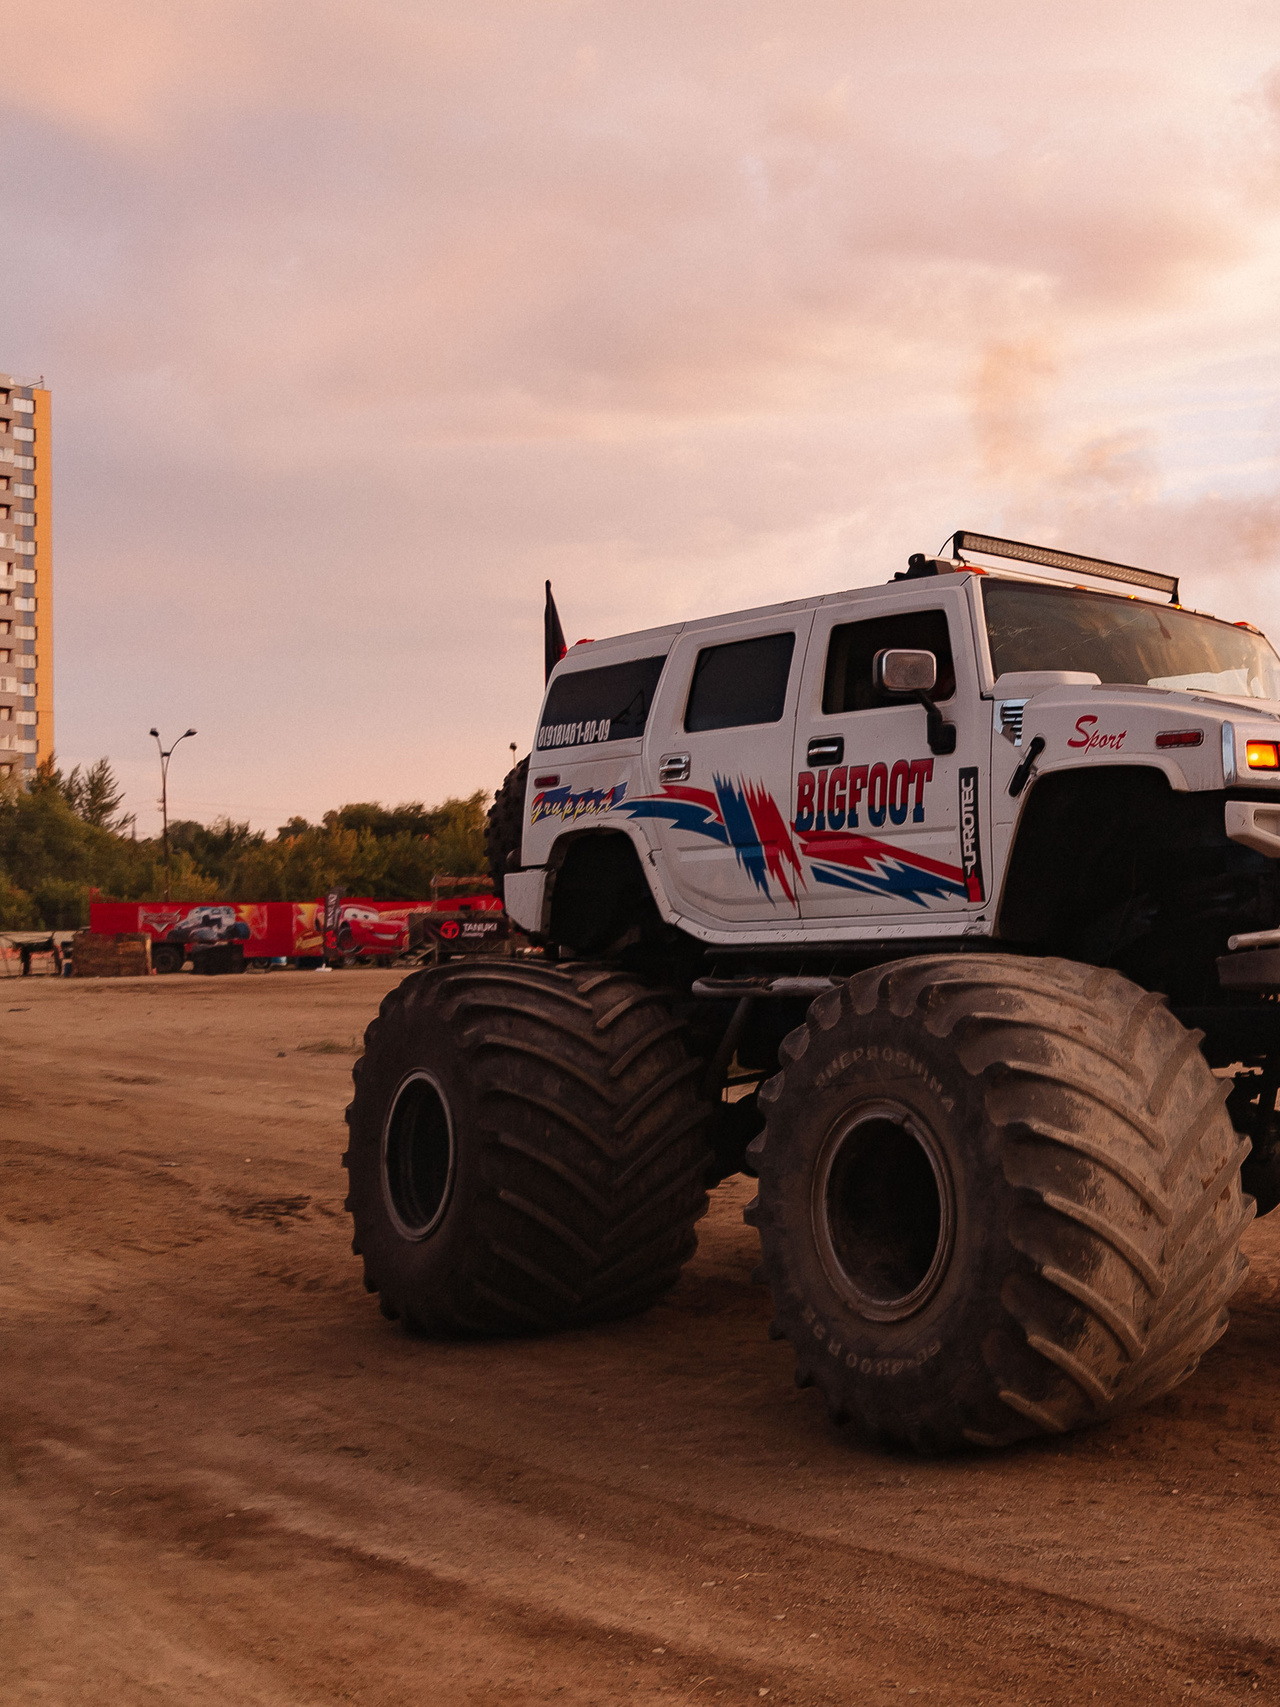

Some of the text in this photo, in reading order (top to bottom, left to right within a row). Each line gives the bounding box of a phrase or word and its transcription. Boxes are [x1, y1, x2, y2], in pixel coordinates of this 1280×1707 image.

[537, 718, 611, 748] 8(918)461-80-09
[1067, 714, 1127, 754] Sport
[794, 758, 935, 832] BIGFOOT
[462, 922, 498, 932] TANUKI
